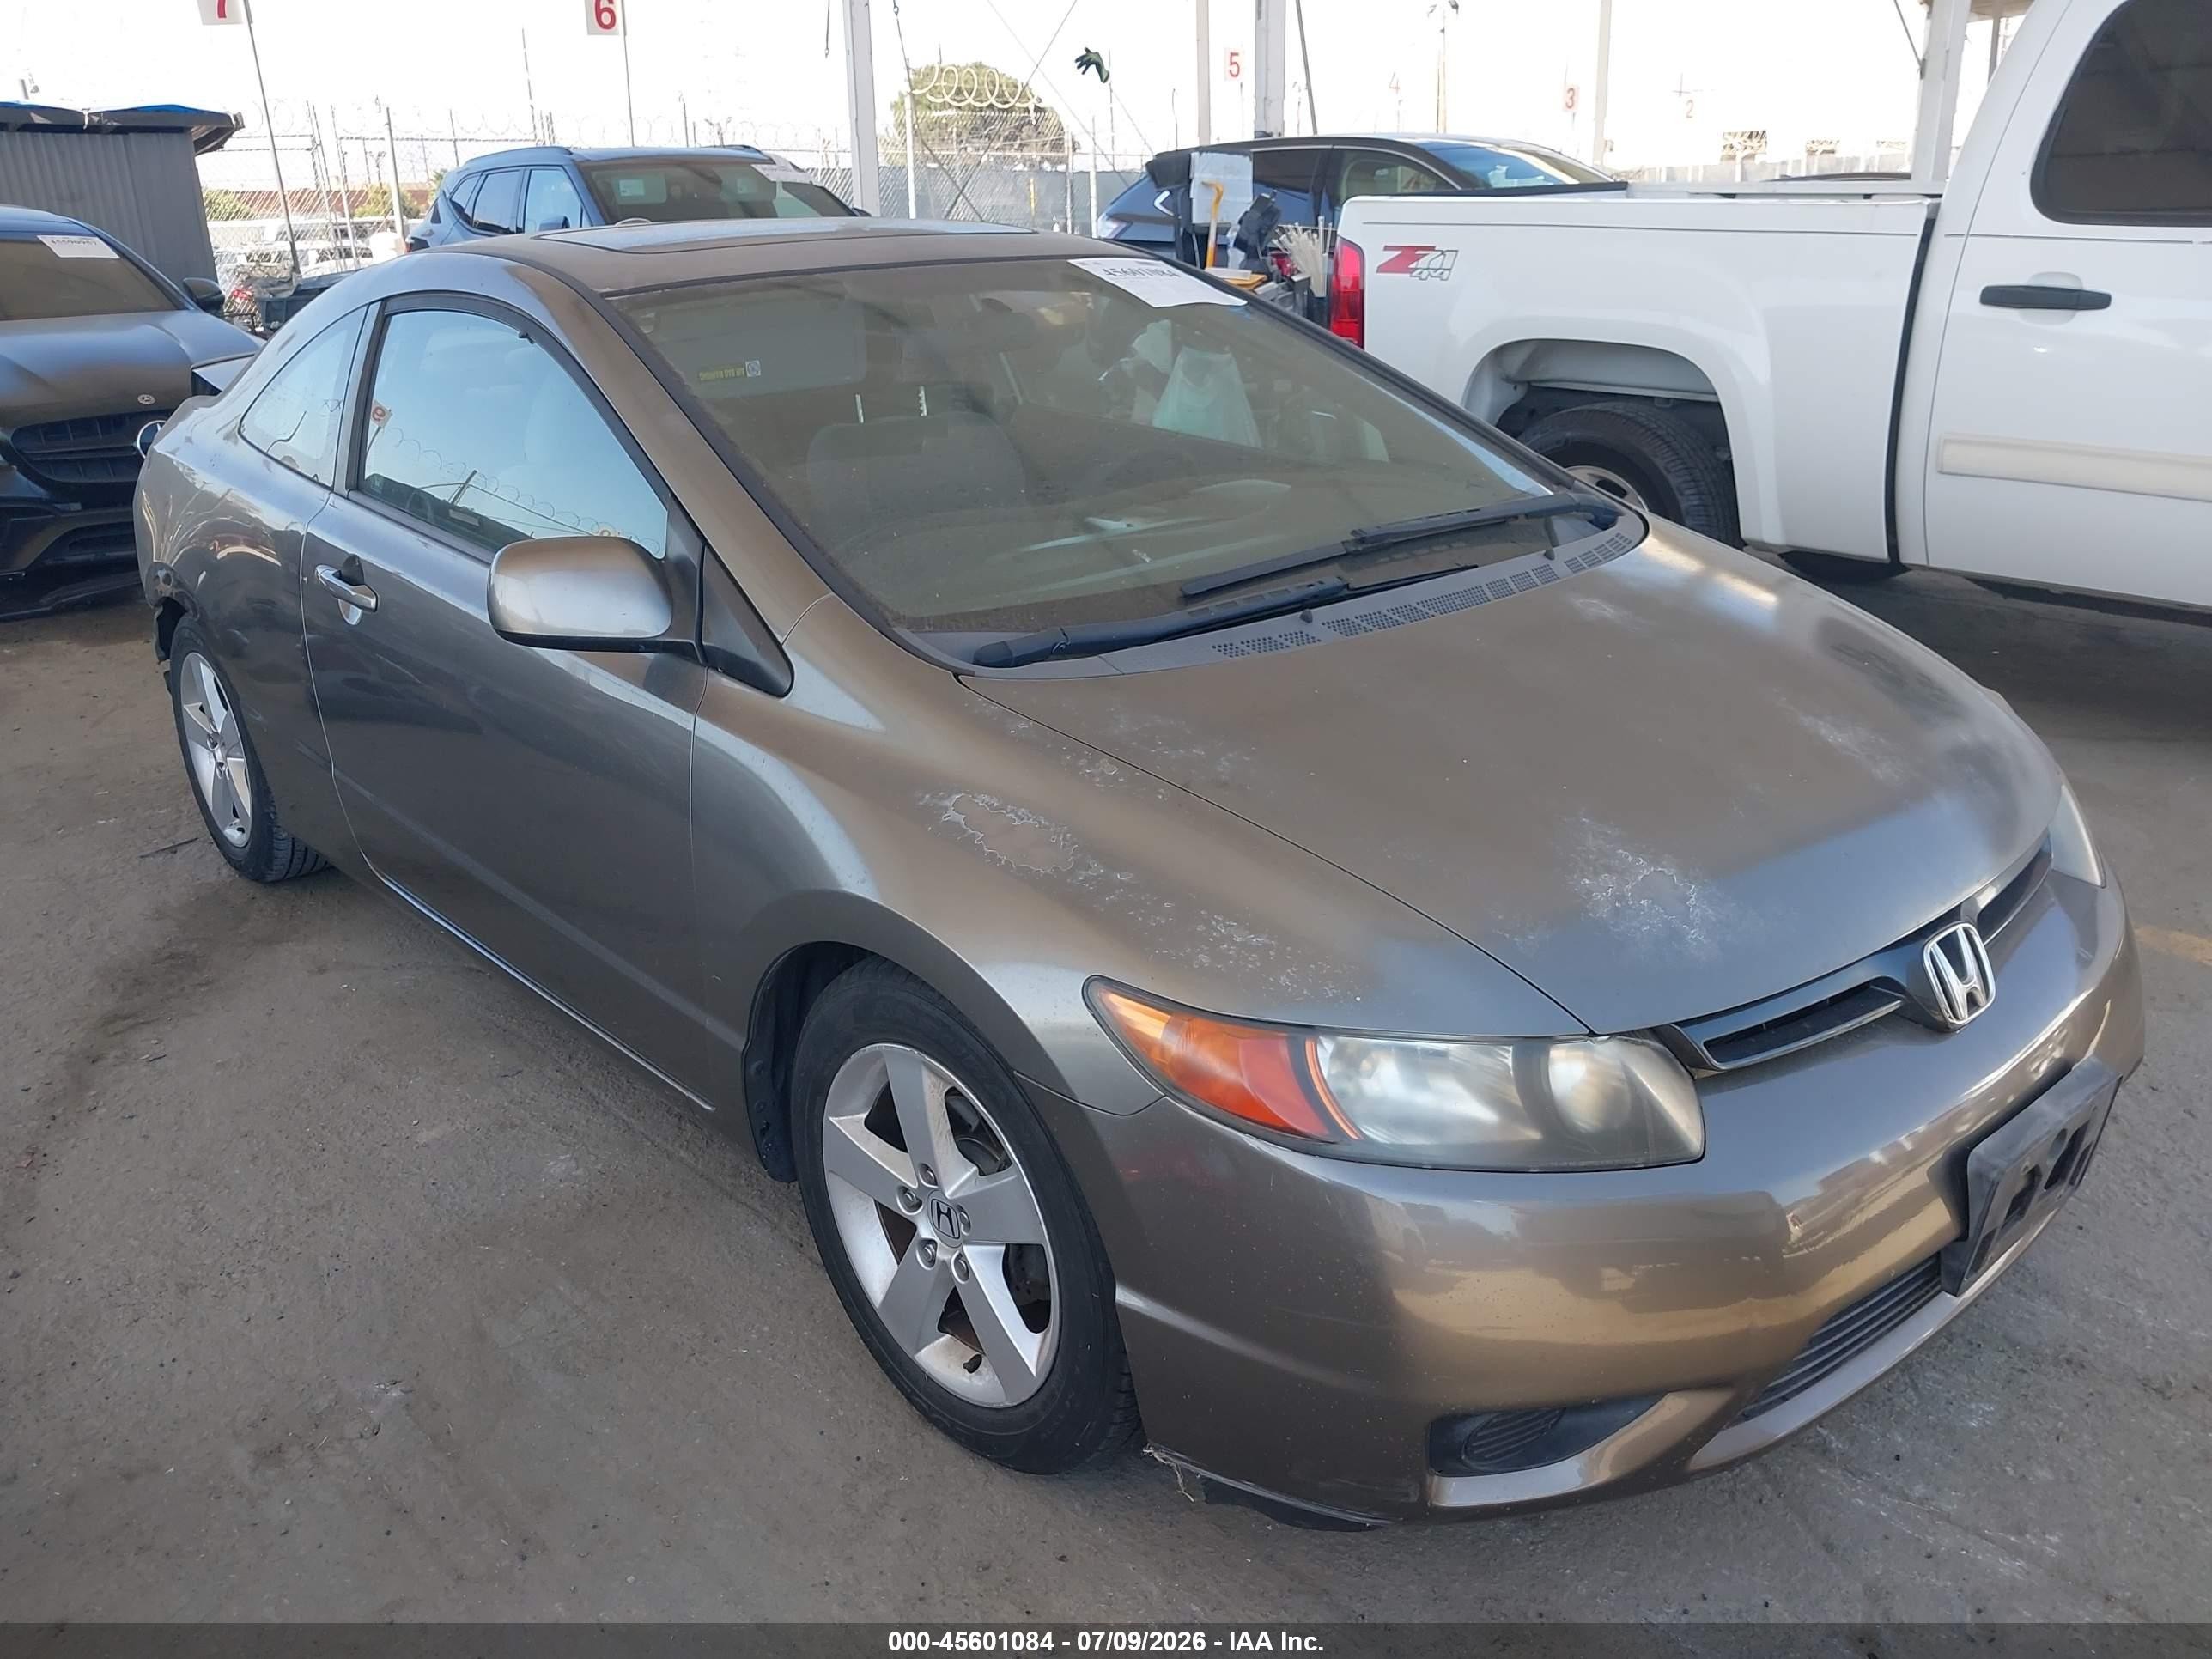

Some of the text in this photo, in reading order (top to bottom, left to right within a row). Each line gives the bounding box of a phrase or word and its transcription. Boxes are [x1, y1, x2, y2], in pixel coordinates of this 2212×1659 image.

[594, 0, 616, 30] 6
[1229, 52, 1240, 77] 5
[1565, 88, 1575, 109] 3
[1686, 99, 1694, 118] 2
